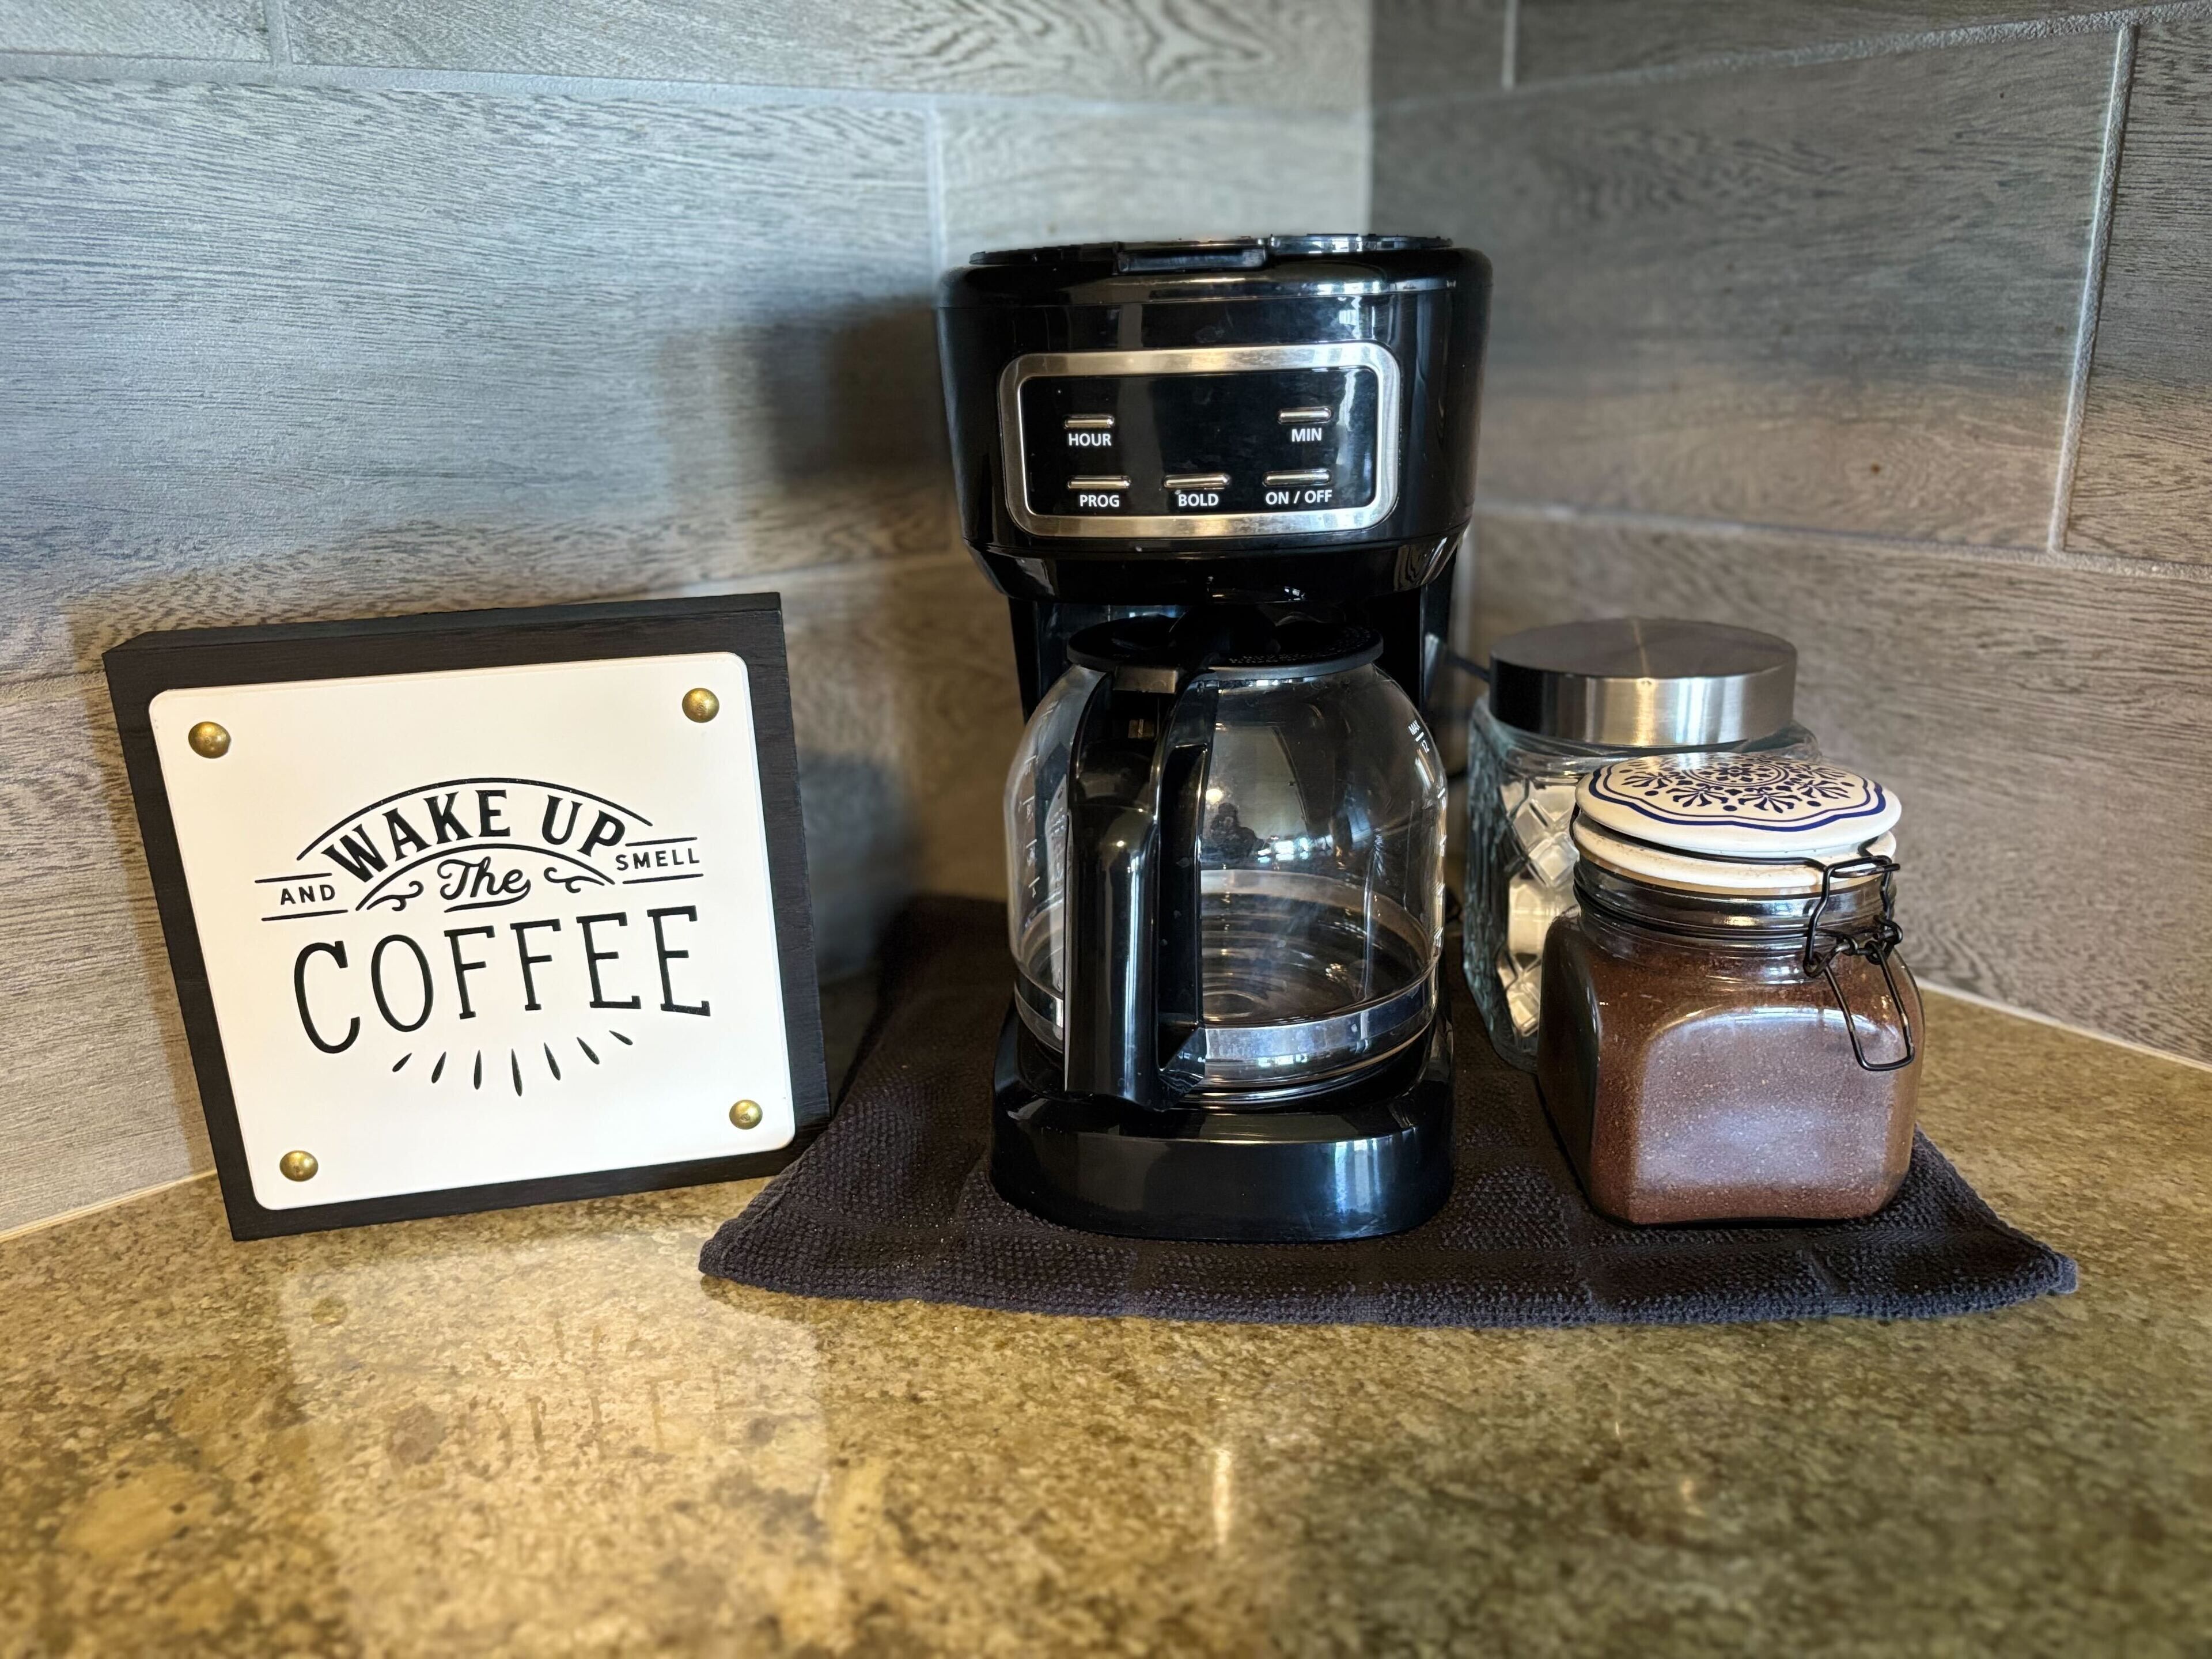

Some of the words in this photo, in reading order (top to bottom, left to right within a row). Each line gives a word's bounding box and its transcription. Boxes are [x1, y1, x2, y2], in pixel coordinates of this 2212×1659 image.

[1068, 433, 1112, 447] HOUR
[1291, 427, 1323, 442] MIN
[1079, 494, 1120, 508] PROG
[1177, 493, 1219, 507] BOLD
[1264, 491, 1290, 506] ON
[1304, 488, 1333, 504] OFF
[1408, 719, 1421, 736] MAX
[320, 789, 510, 882] WAKE
[541, 794, 626, 857] UP
[615, 848, 700, 871] SMELL
[437, 855, 531, 913] The
[280, 884, 336, 906] AND
[293, 905, 711, 1054] COFFEE
